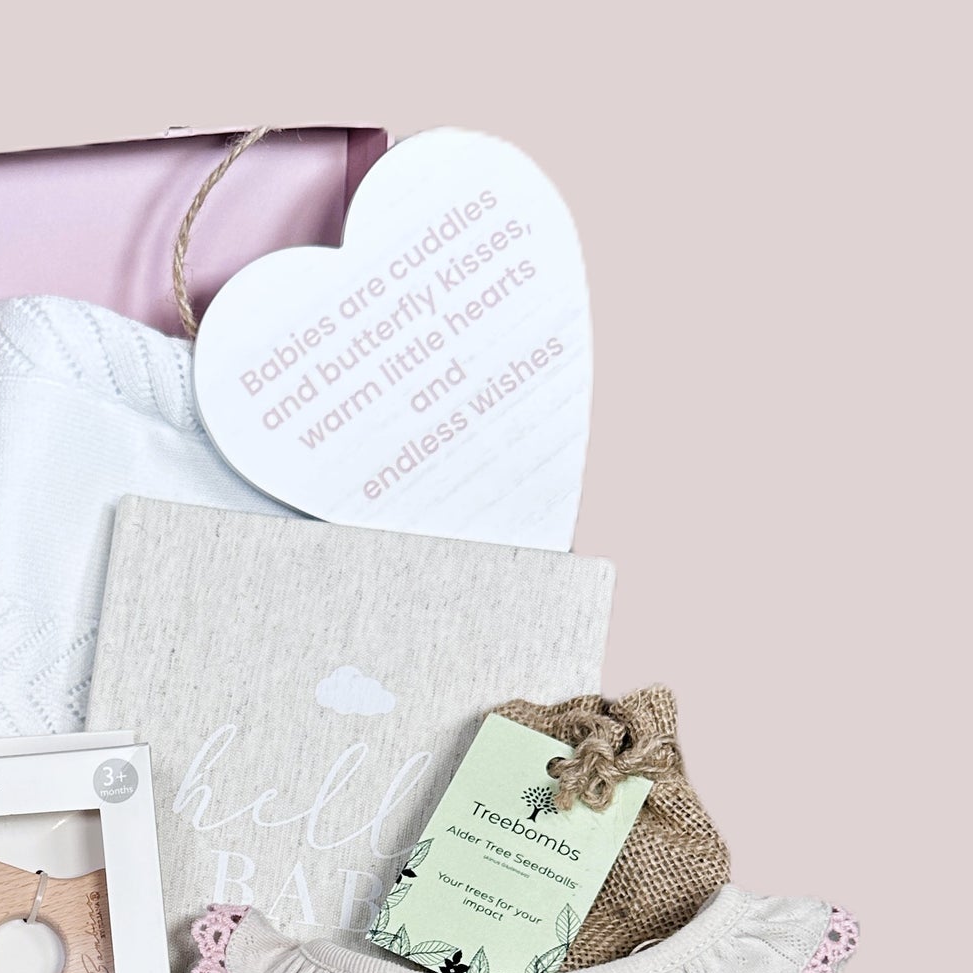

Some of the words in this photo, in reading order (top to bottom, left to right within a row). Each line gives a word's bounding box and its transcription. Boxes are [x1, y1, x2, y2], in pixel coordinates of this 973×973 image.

[239, 314, 336, 397] Babies
[338, 276, 386, 321] are
[389, 189, 498, 280] cuddles
[261, 375, 319, 431] and
[316, 285, 436, 386] butterfly
[434, 217, 533, 292] kisses,
[298, 385, 383, 450] warm
[379, 330, 445, 386] little
[443, 259, 537, 336] hearts
[410, 358, 467, 413] and
[362, 411, 468, 500] endless
[468, 336, 564, 416] wishes
[100, 785, 134, 797] months
[102, 766, 128, 787] 3+
[172, 723, 432, 859] hell
[446, 824, 482, 846] Alder
[485, 839, 512, 859] Tree
[473, 800, 582, 862] Treebombs
[211, 850, 383, 932] BAB
[438, 871, 464, 889] Your
[465, 884, 495, 905] trees
[495, 898, 515, 913] for
[514, 905, 543, 925] your
[462, 897, 504, 922] impact
